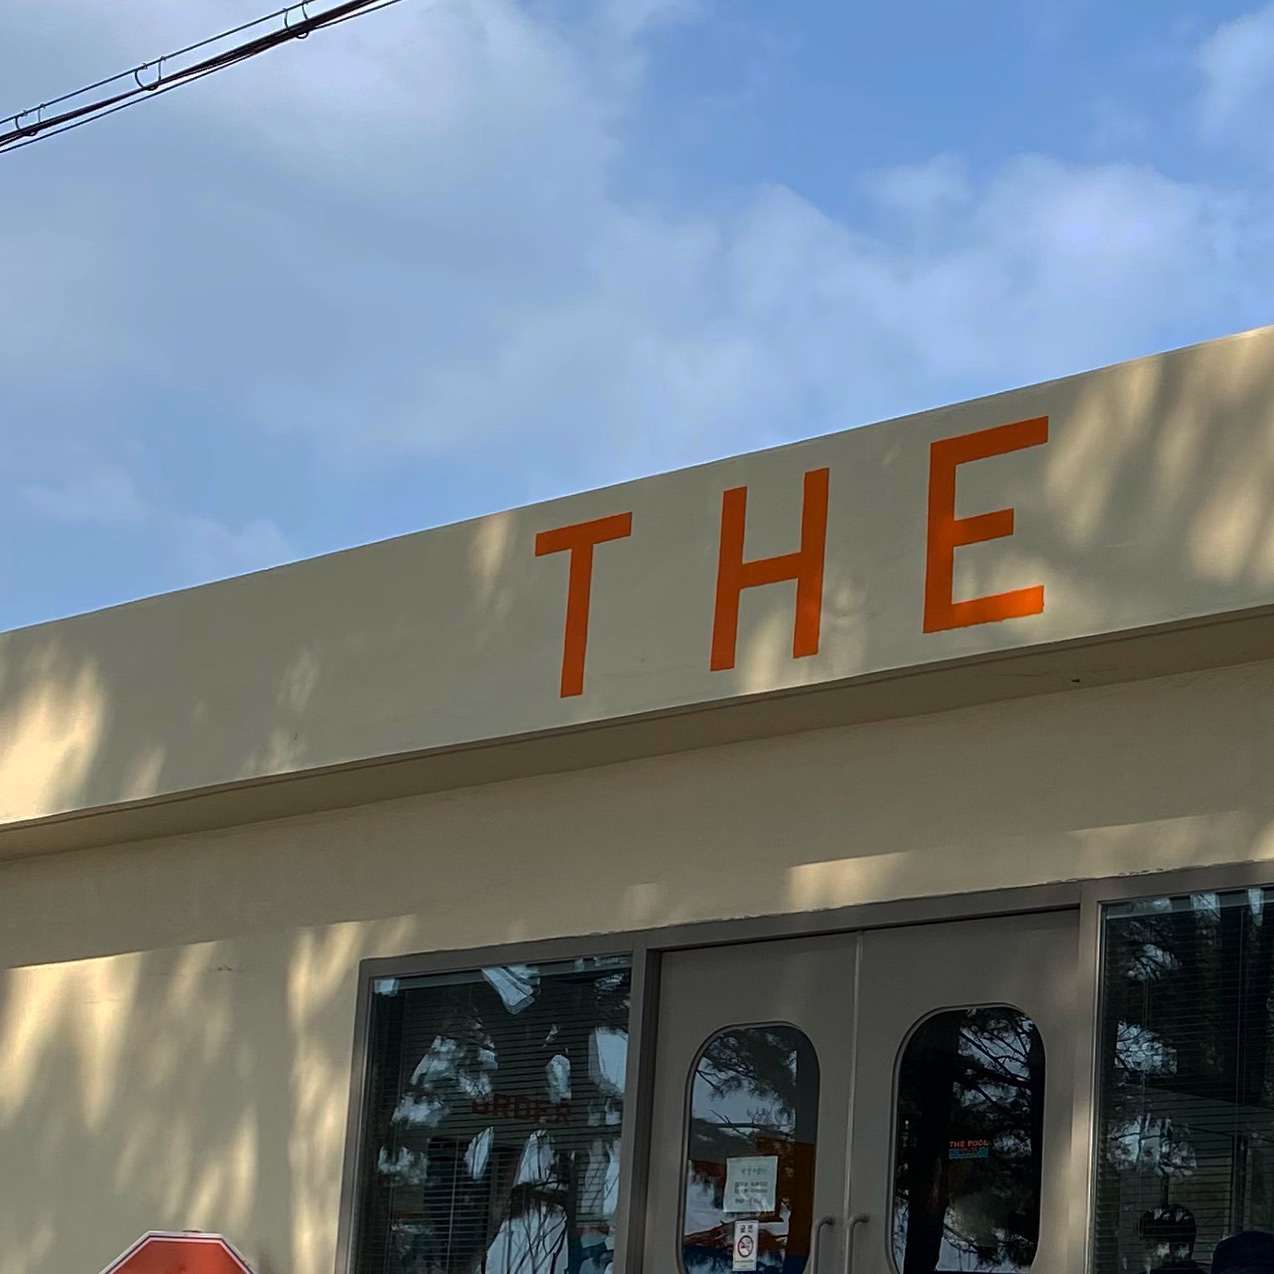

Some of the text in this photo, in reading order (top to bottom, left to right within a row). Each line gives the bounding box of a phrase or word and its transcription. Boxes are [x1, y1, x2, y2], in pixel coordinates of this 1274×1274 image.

[535, 416, 1049, 698] THE
[949, 1138, 989, 1148] THE POOL
